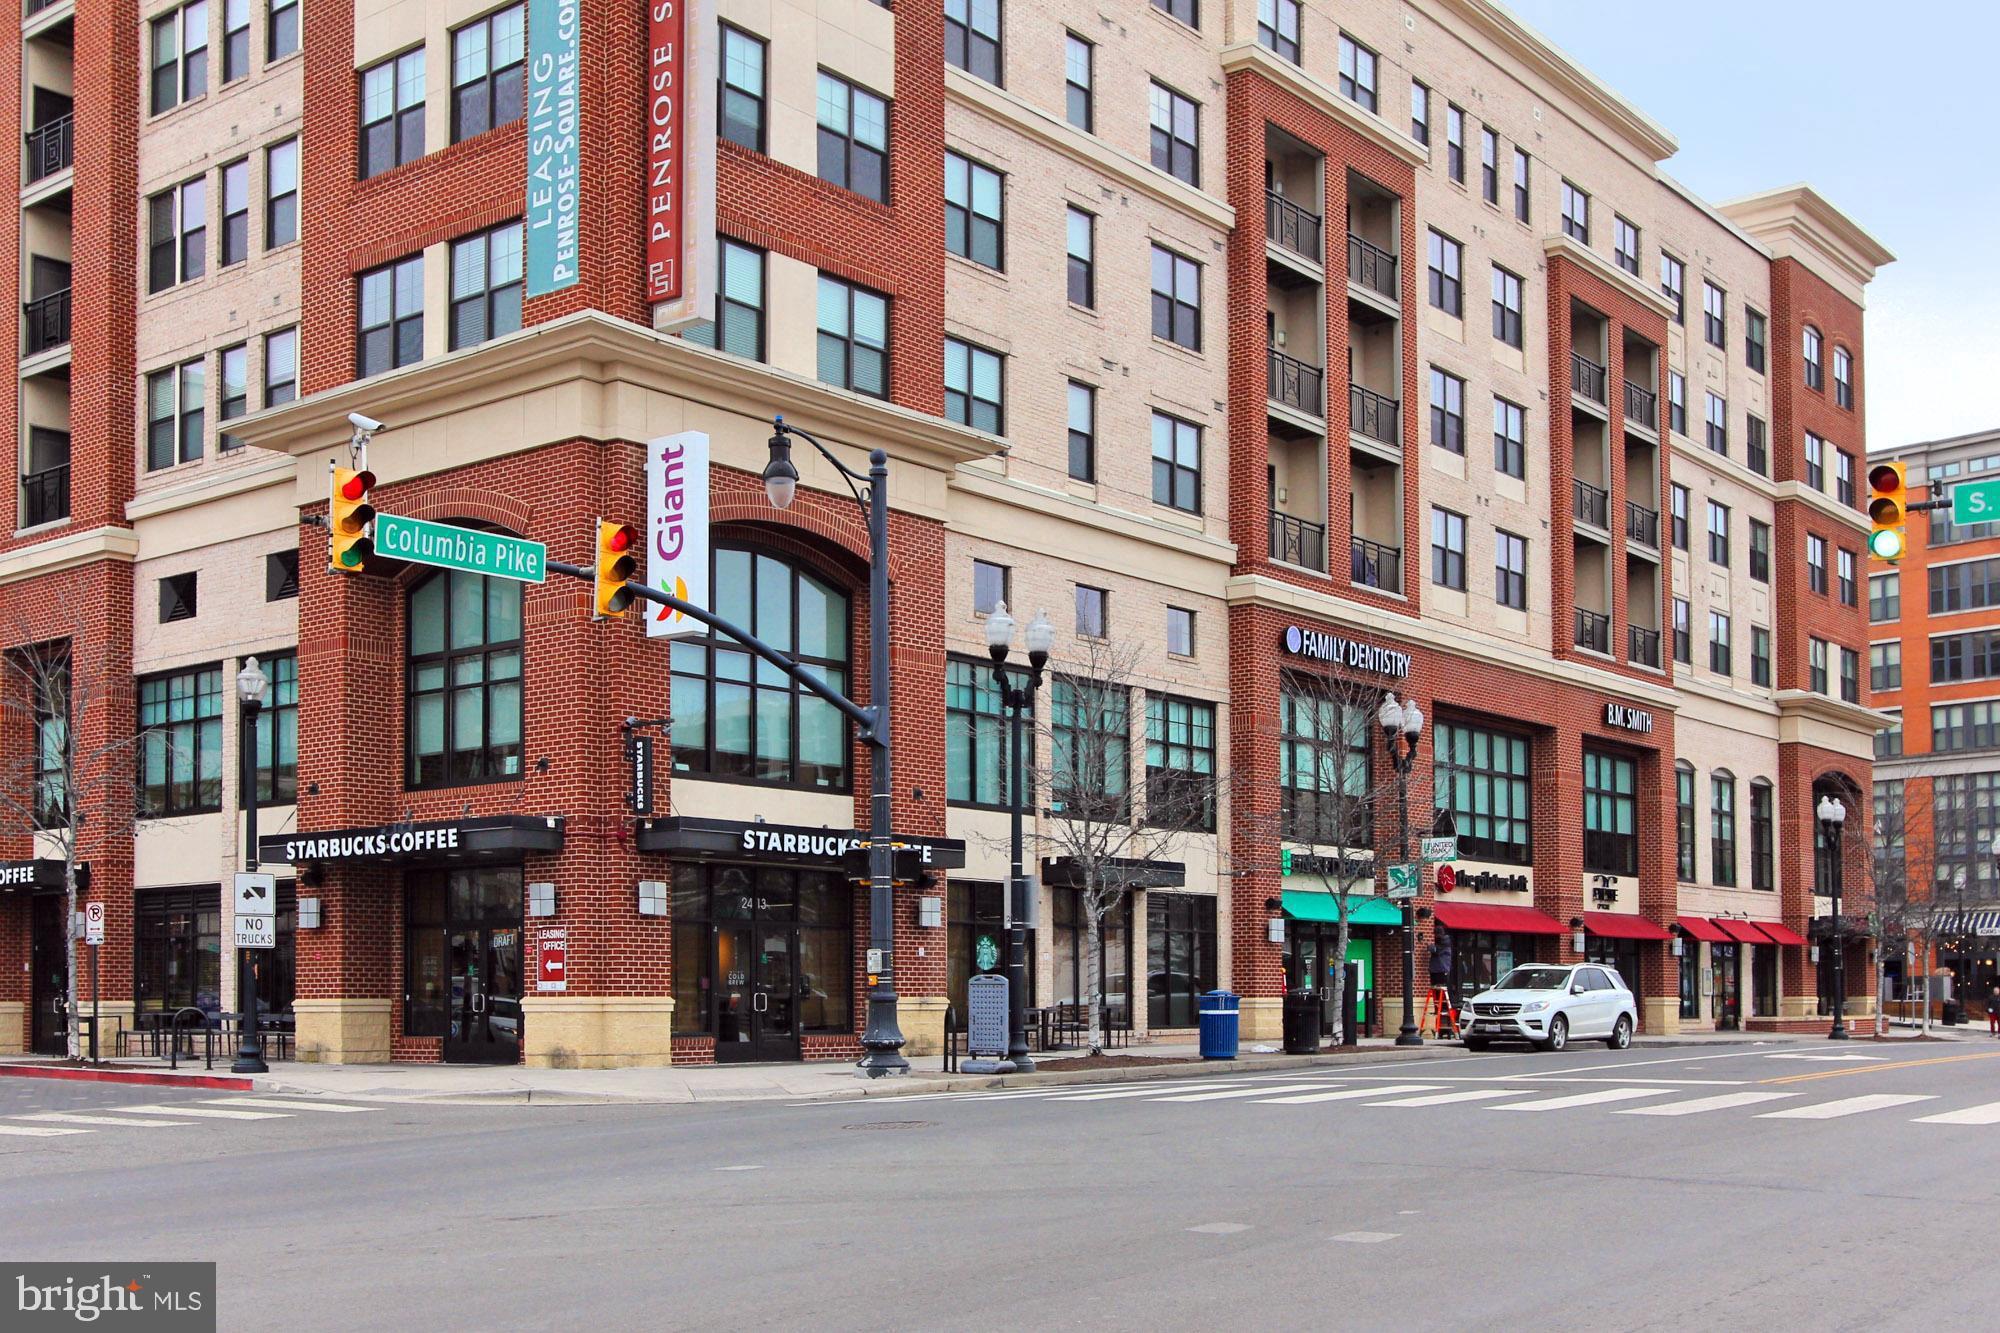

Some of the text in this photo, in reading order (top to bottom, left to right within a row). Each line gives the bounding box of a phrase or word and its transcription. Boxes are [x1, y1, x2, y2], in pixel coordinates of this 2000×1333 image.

[533, 53, 553, 229] LEASING
[652, 42, 673, 243] PENROSE
[656, 443, 684, 561] Giant
[1968, 491, 1993, 513] S.
[385, 523, 538, 574] Columbia Pike
[1303, 629, 1411, 678] FAMILY DENTISTRY
[1608, 703, 1653, 733] B.M. SMITH
[636, 741, 645, 809] STARBUCKS
[286, 828, 459, 860] STARBUCKS COFFEE
[236, 933, 273, 944] TRUCKS
[246, 918, 263, 930] NO
[539, 930, 564, 939] LEASING
[493, 934, 514, 948] DRAFT
[543, 941, 564, 951] OFFICE
